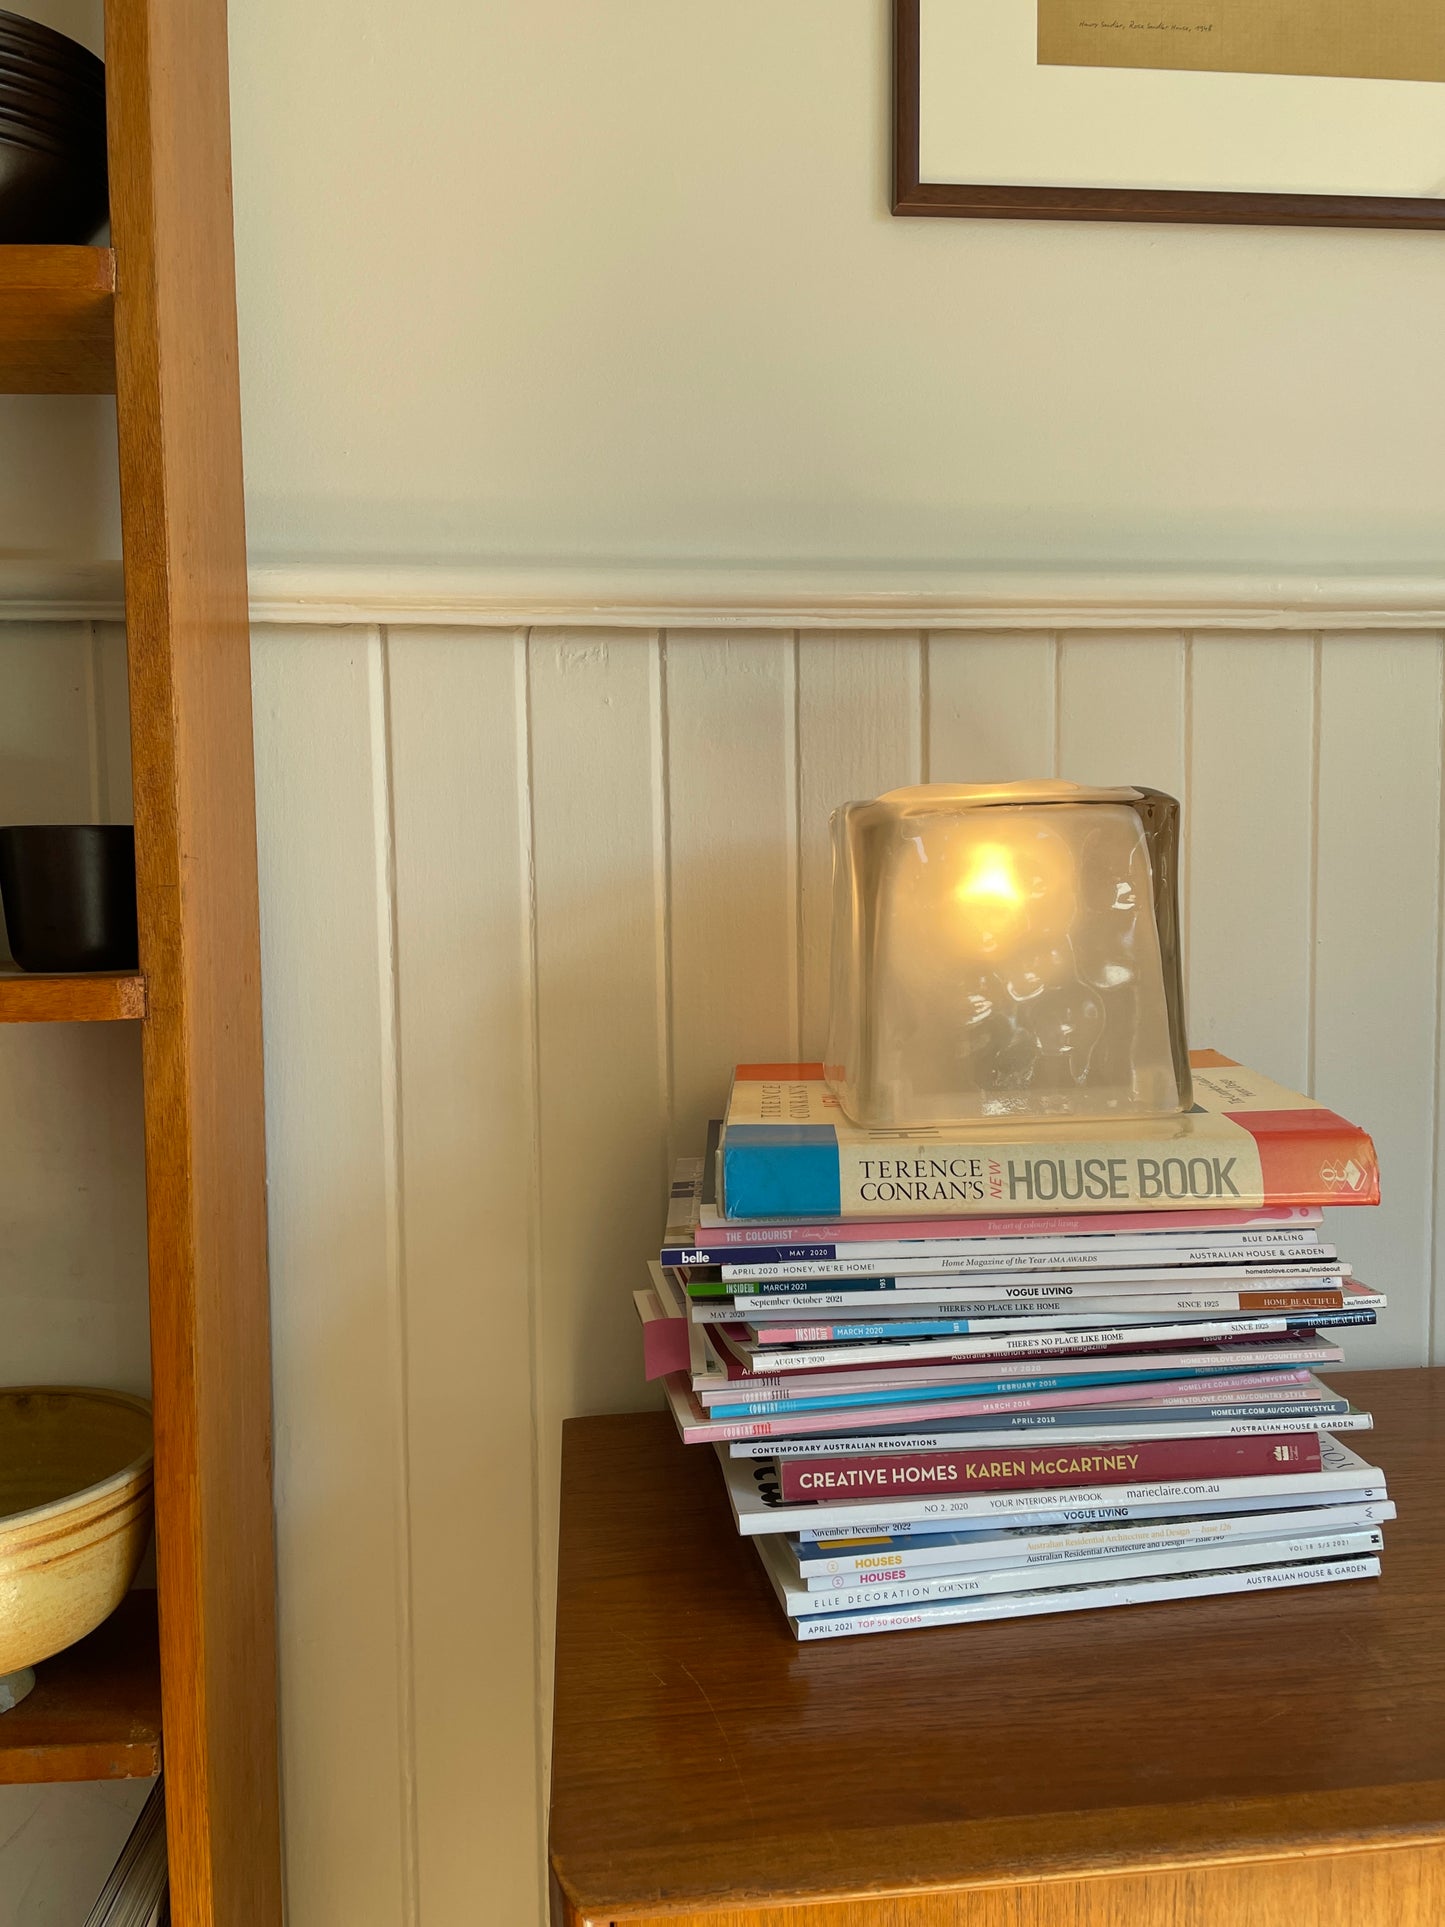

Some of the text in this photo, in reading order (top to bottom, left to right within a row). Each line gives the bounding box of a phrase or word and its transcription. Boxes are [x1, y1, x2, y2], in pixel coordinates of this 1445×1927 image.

[1128, 20, 1145, 29] Rose
[859, 1159, 983, 1179] TERENCE
[987, 1158, 1004, 1199] NEW
[1008, 1157, 1241, 1200] HOUSE BOOK
[860, 1180, 984, 1201] CONRAN'S
[988, 1221, 1001, 1230] The
[1024, 1219, 1057, 1229] colourful
[726, 1231, 742, 1242] THE
[745, 1230, 793, 1241] COLOURIST
[1266, 1234, 1304, 1242] DARLING
[681, 1251, 711, 1264] belle
[1189, 1251, 1244, 1260] AUSTRALIAN
[1246, 1250, 1277, 1258] HOUSE
[1288, 1248, 1325, 1257] GARDEN
[942, 1259, 964, 1268] Home
[965, 1257, 1005, 1269] Magazine
[1006, 1256, 1015, 1267] of
[1015, 1256, 1027, 1265] the
[1029, 1256, 1046, 1264] Year
[732, 1263, 876, 1276] APRIL 2020 HONEY, WE'RE HOME!
[1245, 1266, 1341, 1275] homestolove.com.au/insideout
[763, 1283, 789, 1292] MARCH
[791, 1283, 808, 1291] 2021
[1006, 1286, 1074, 1297] VOGUE LIVING
[750, 1295, 844, 1309] September October 2021
[938, 1302, 1060, 1313] THERE'S NO PLACE LIKE HOME
[1177, 1300, 1220, 1309] SINCE 1925
[1263, 1297, 1338, 1306] HOME BEAUTIFUL
[710, 1310, 746, 1319] MAY 2020
[1307, 1315, 1373, 1327] HOME BEAUTIFUL
[795, 1326, 884, 1341] INSIDE MARCH 2020
[1231, 1322, 1270, 1332] SINCE 1925
[1007, 1333, 1124, 1348] THERE'S NO PLACE LIKE HOME
[774, 1355, 825, 1366] AUGUST 2020
[997, 1381, 1037, 1390] FEBRUARY
[983, 1402, 1011, 1410] MARCH
[1211, 1405, 1336, 1416] HOMELIFE.COM.AU/COUNTRYSTYLE
[1011, 1416, 1056, 1425] APRIL 2018
[1231, 1420, 1354, 1433] AUSTRALIAN HOUSE & GARDEN
[752, 1440, 937, 1455] CONTEMPORARY AUSTRALIAN RENOVATIONS
[800, 1469, 887, 1489] CREATIVE
[892, 1465, 958, 1484] HOMES
[965, 1460, 1025, 1479] KAREN
[924, 1504, 939, 1513] NO
[950, 1502, 969, 1511] 2020
[990, 1500, 1014, 1509] YOUR
[1015, 1496, 1057, 1507] INTERIORS
[1059, 1493, 1103, 1504] PLAYBOOK
[1126, 1484, 1220, 1499] marieclaire.com.au
[811, 1508, 1128, 1538] November December 2022 VOGUE LIVING
[1026, 1540, 1064, 1551] Australian
[1065, 1535, 1105, 1547] Residential
[1106, 1531, 1150, 1543] Architecture
[1151, 1530, 1164, 1539] and
[1166, 1527, 1191, 1538] Design
[1333, 1540, 1350, 1548] 2021
[1026, 1552, 1063, 1563] Australian
[1064, 1547, 1103, 1559] Residential
[1103, 1543, 1146, 1555] Architecture
[1147, 1541, 1161, 1549] and
[855, 1555, 903, 1569] HOUSES
[860, 1570, 906, 1584] HOUSES
[1246, 1564, 1368, 1585] AUSTRALIAN HOUSE & GARDEN
[814, 1581, 981, 1608] ELLE DECORATION COUNTRY
[808, 1615, 922, 1634] APRIL 2021 TOP 50 ROOMS
